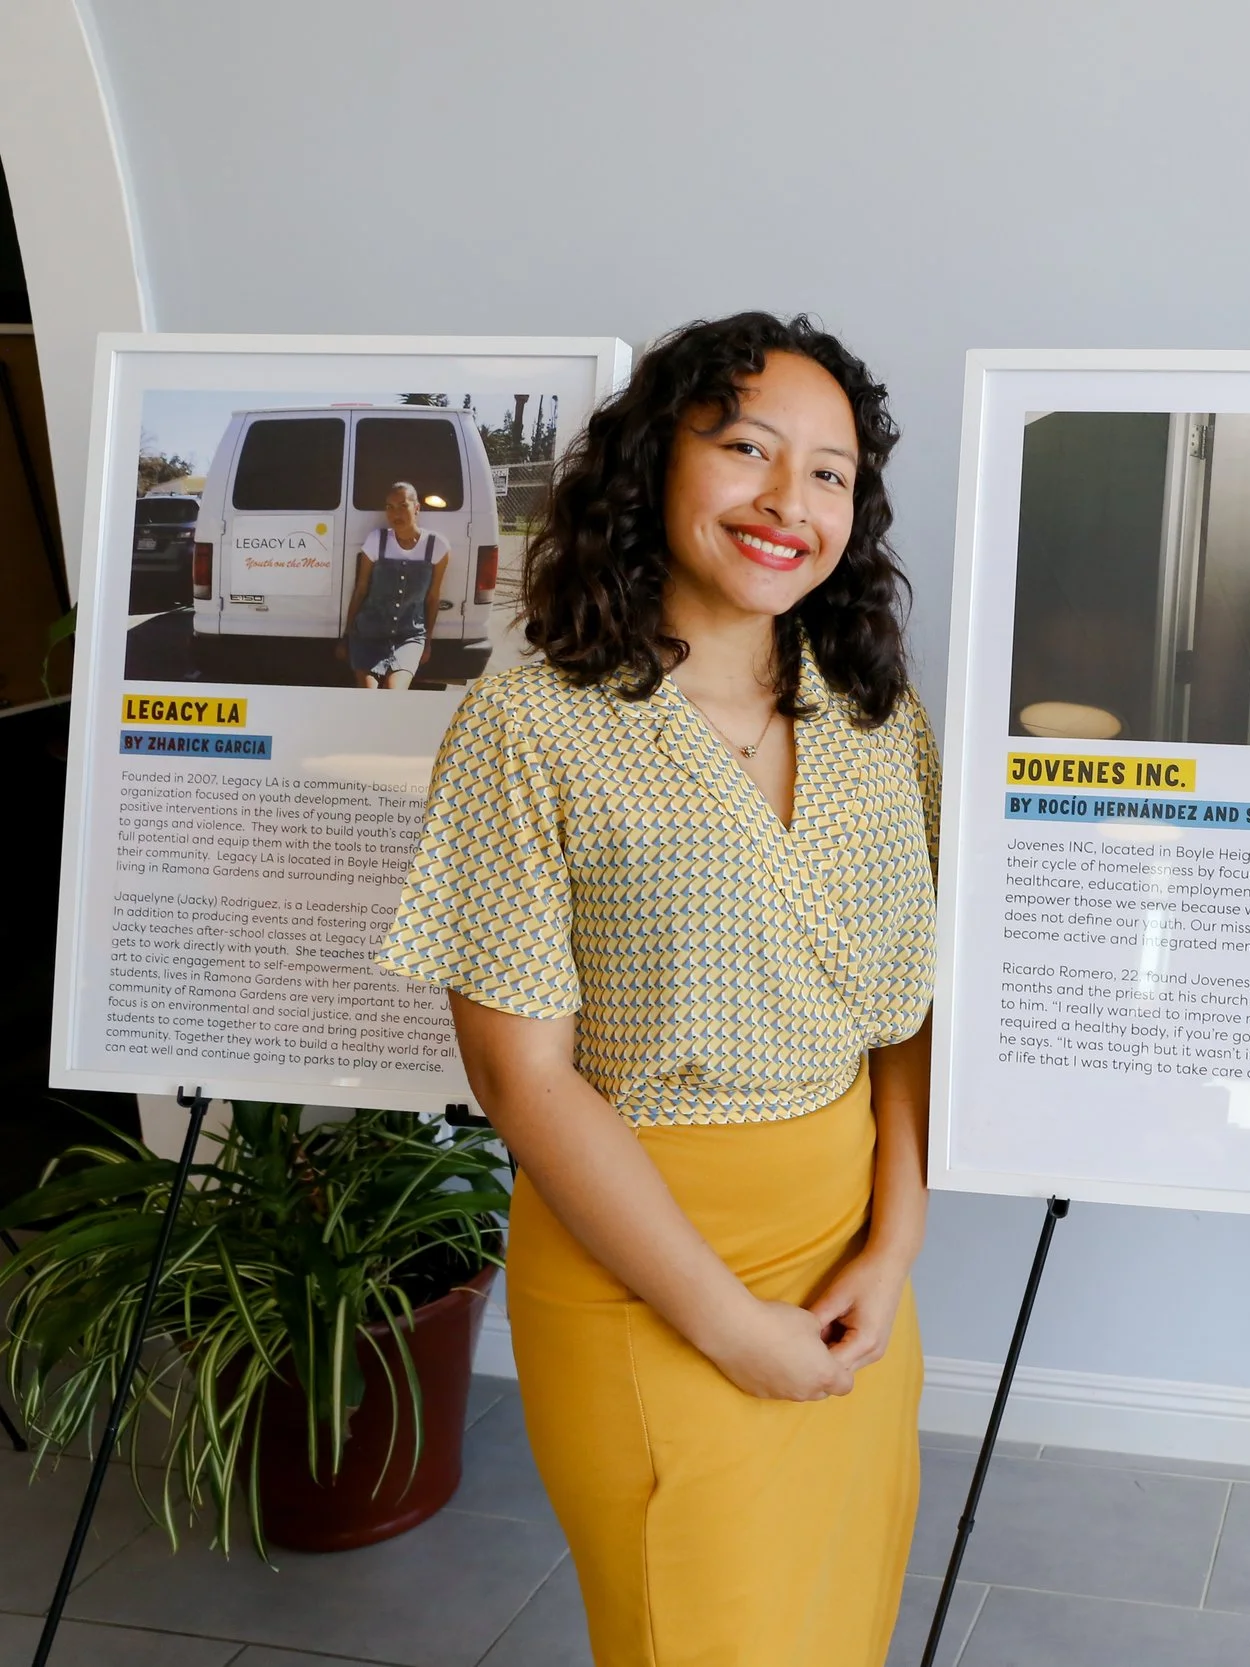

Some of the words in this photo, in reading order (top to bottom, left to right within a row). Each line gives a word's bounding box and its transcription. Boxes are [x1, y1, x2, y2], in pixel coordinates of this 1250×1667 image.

[236, 538, 285, 549] LEGACY
[245, 557, 273, 570] Youth
[287, 558, 301, 568] the
[301, 557, 330, 568] Move
[126, 700, 209, 722] LEGACY
[217, 703, 240, 723] LA
[124, 736, 143, 749] BY
[148, 737, 209, 752] ZHARICK
[215, 740, 265, 754] GARCIA
[121, 770, 170, 783] Founded
[174, 772, 183, 783] in
[222, 774, 262, 789] Legacy
[265, 776, 279, 787] LA
[281, 776, 289, 788] is
[292, 779, 300, 788] a
[303, 780, 407, 793] community-based
[1012, 758, 1125, 784] JOVENES
[1136, 763, 1186, 788] INC.
[120, 786, 191, 799] organization
[195, 788, 238, 801] focused
[241, 792, 256, 801] on
[258, 792, 291, 804] youth
[293, 792, 371, 807] development.
[378, 796, 405, 808] Their
[1010, 797, 1032, 813] BY
[1038, 796, 1087, 816] ROCÍO
[1094, 799, 1198, 821] HERNÁNDEZ
[1203, 806, 1239, 823] AND
[1007, 838, 1064, 852] Jovenes
[1069, 840, 1096, 854] INC,
[1101, 841, 1154, 856] located
[1159, 844, 1171, 857] in
[1176, 845, 1214, 862] Boyle
[1007, 855, 1038, 868] their
[1041, 857, 1076, 872] cycle
[1080, 858, 1096, 871] of
[1098, 859, 1193, 877] homelessness
[1197, 864, 1214, 880] by
[1006, 872, 1083, 889] healthcare,
[1088, 877, 1162, 893] education,
[1004, 893, 1070, 907] empower
[1074, 894, 1112, 908] those
[1115, 899, 1136, 909] we
[1140, 900, 1176, 912] serve
[1181, 899, 1240, 915] because
[1003, 908, 1037, 922] does
[1040, 912, 1065, 924] not
[1067, 912, 1113, 926] define
[1115, 917, 1139, 927] our
[1142, 917, 1186, 931] youth.
[1189, 918, 1217, 932] Our
[1003, 926, 1060, 941] become
[1062, 930, 1106, 944] active
[1109, 933, 1138, 945] and
[1141, 933, 1218, 951] integrated
[105, 1028, 171, 1042] community.
[174, 1029, 224, 1044] Together
[227, 1033, 252, 1047] they
[254, 1035, 281, 1047] work
[284, 1037, 296, 1048] to
[299, 1037, 327, 1050] build
[330, 1041, 338, 1050] a
[341, 1039, 384, 1055] healthy
[387, 1044, 418, 1055] world
[422, 1044, 437, 1056] for
[440, 1046, 456, 1058] all,
[105, 1043, 125, 1052] can
[128, 1044, 148, 1054] eat
[150, 1044, 173, 1055] well
[175, 1046, 198, 1057] and
[201, 1048, 250, 1060] continue
[253, 1050, 285, 1065] going
[288, 1053, 301, 1063] to
[303, 1054, 334, 1066] parks
[337, 1056, 350, 1066] to
[353, 1056, 377, 1070] play
[380, 1060, 392, 1069] or
[394, 1060, 443, 1072] exercise.
